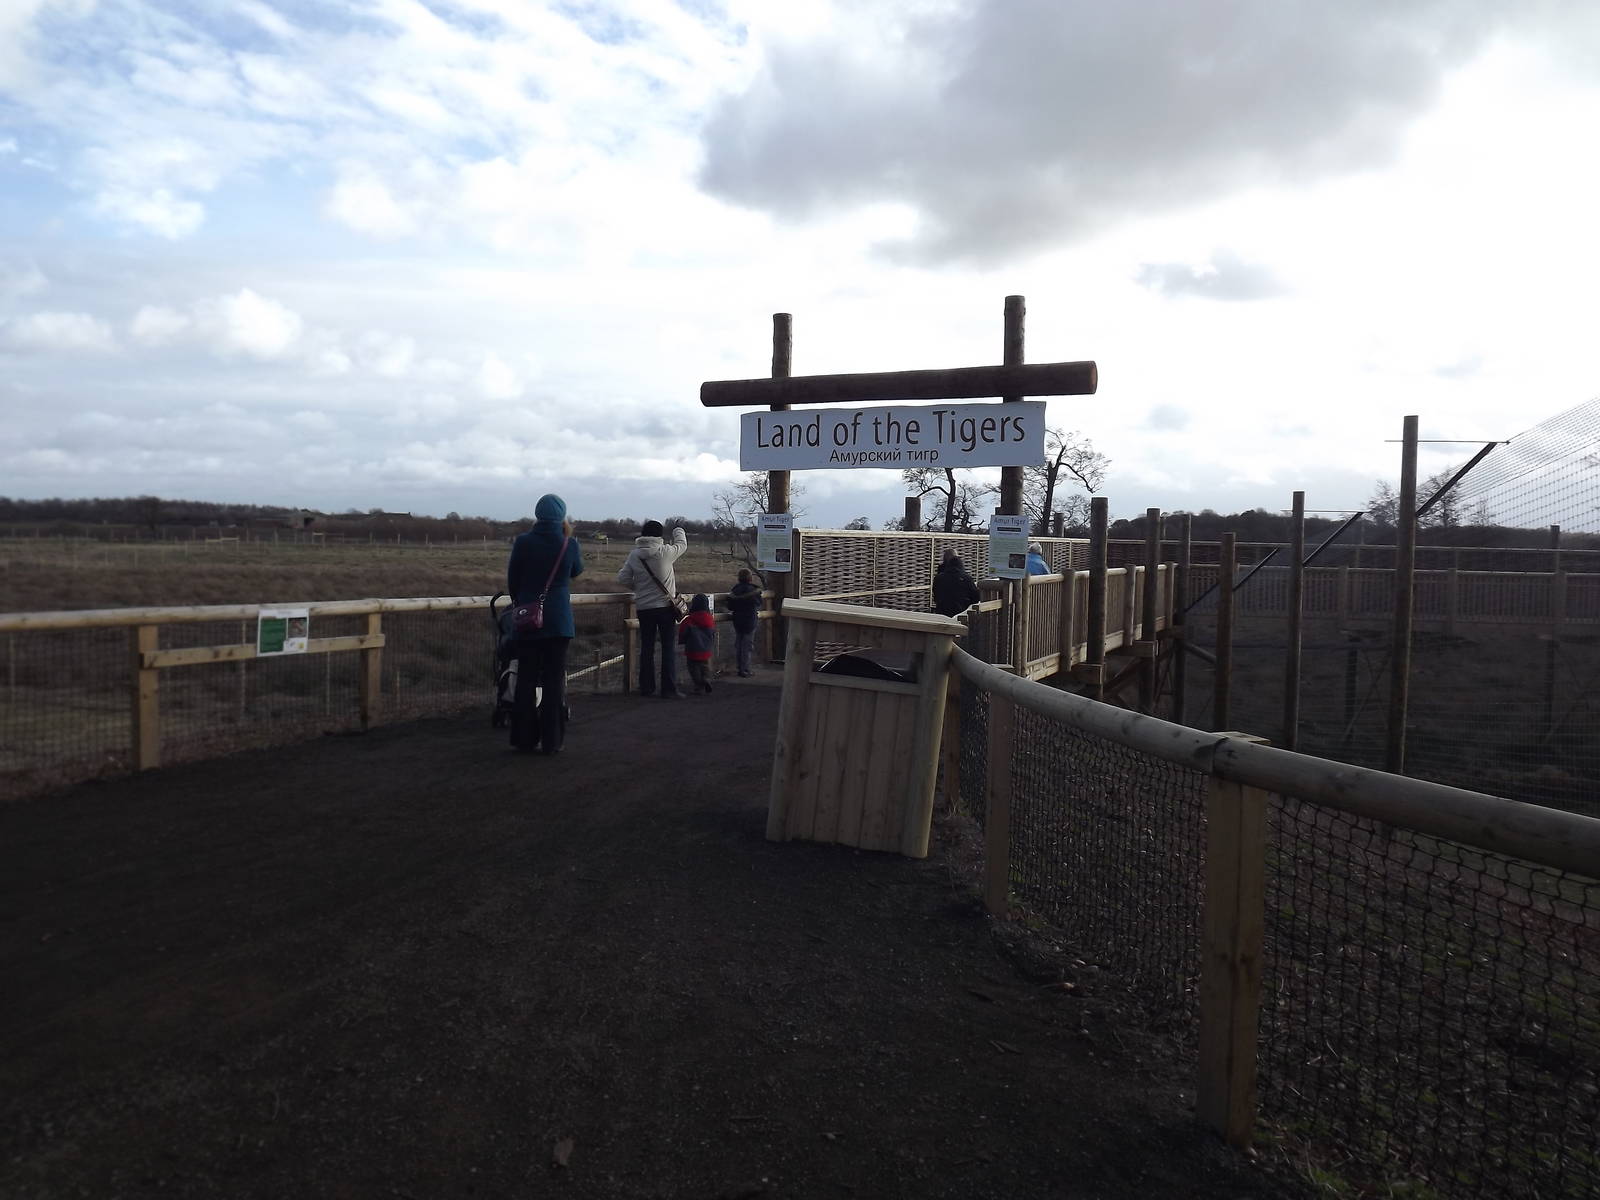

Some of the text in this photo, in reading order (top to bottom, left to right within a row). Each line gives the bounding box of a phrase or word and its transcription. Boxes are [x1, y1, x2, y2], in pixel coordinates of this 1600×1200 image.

[757, 410, 1026, 452] Land of the Tigers
[829, 447, 939, 466] Амурский тигр
[1011, 517, 1026, 527] Tiger
